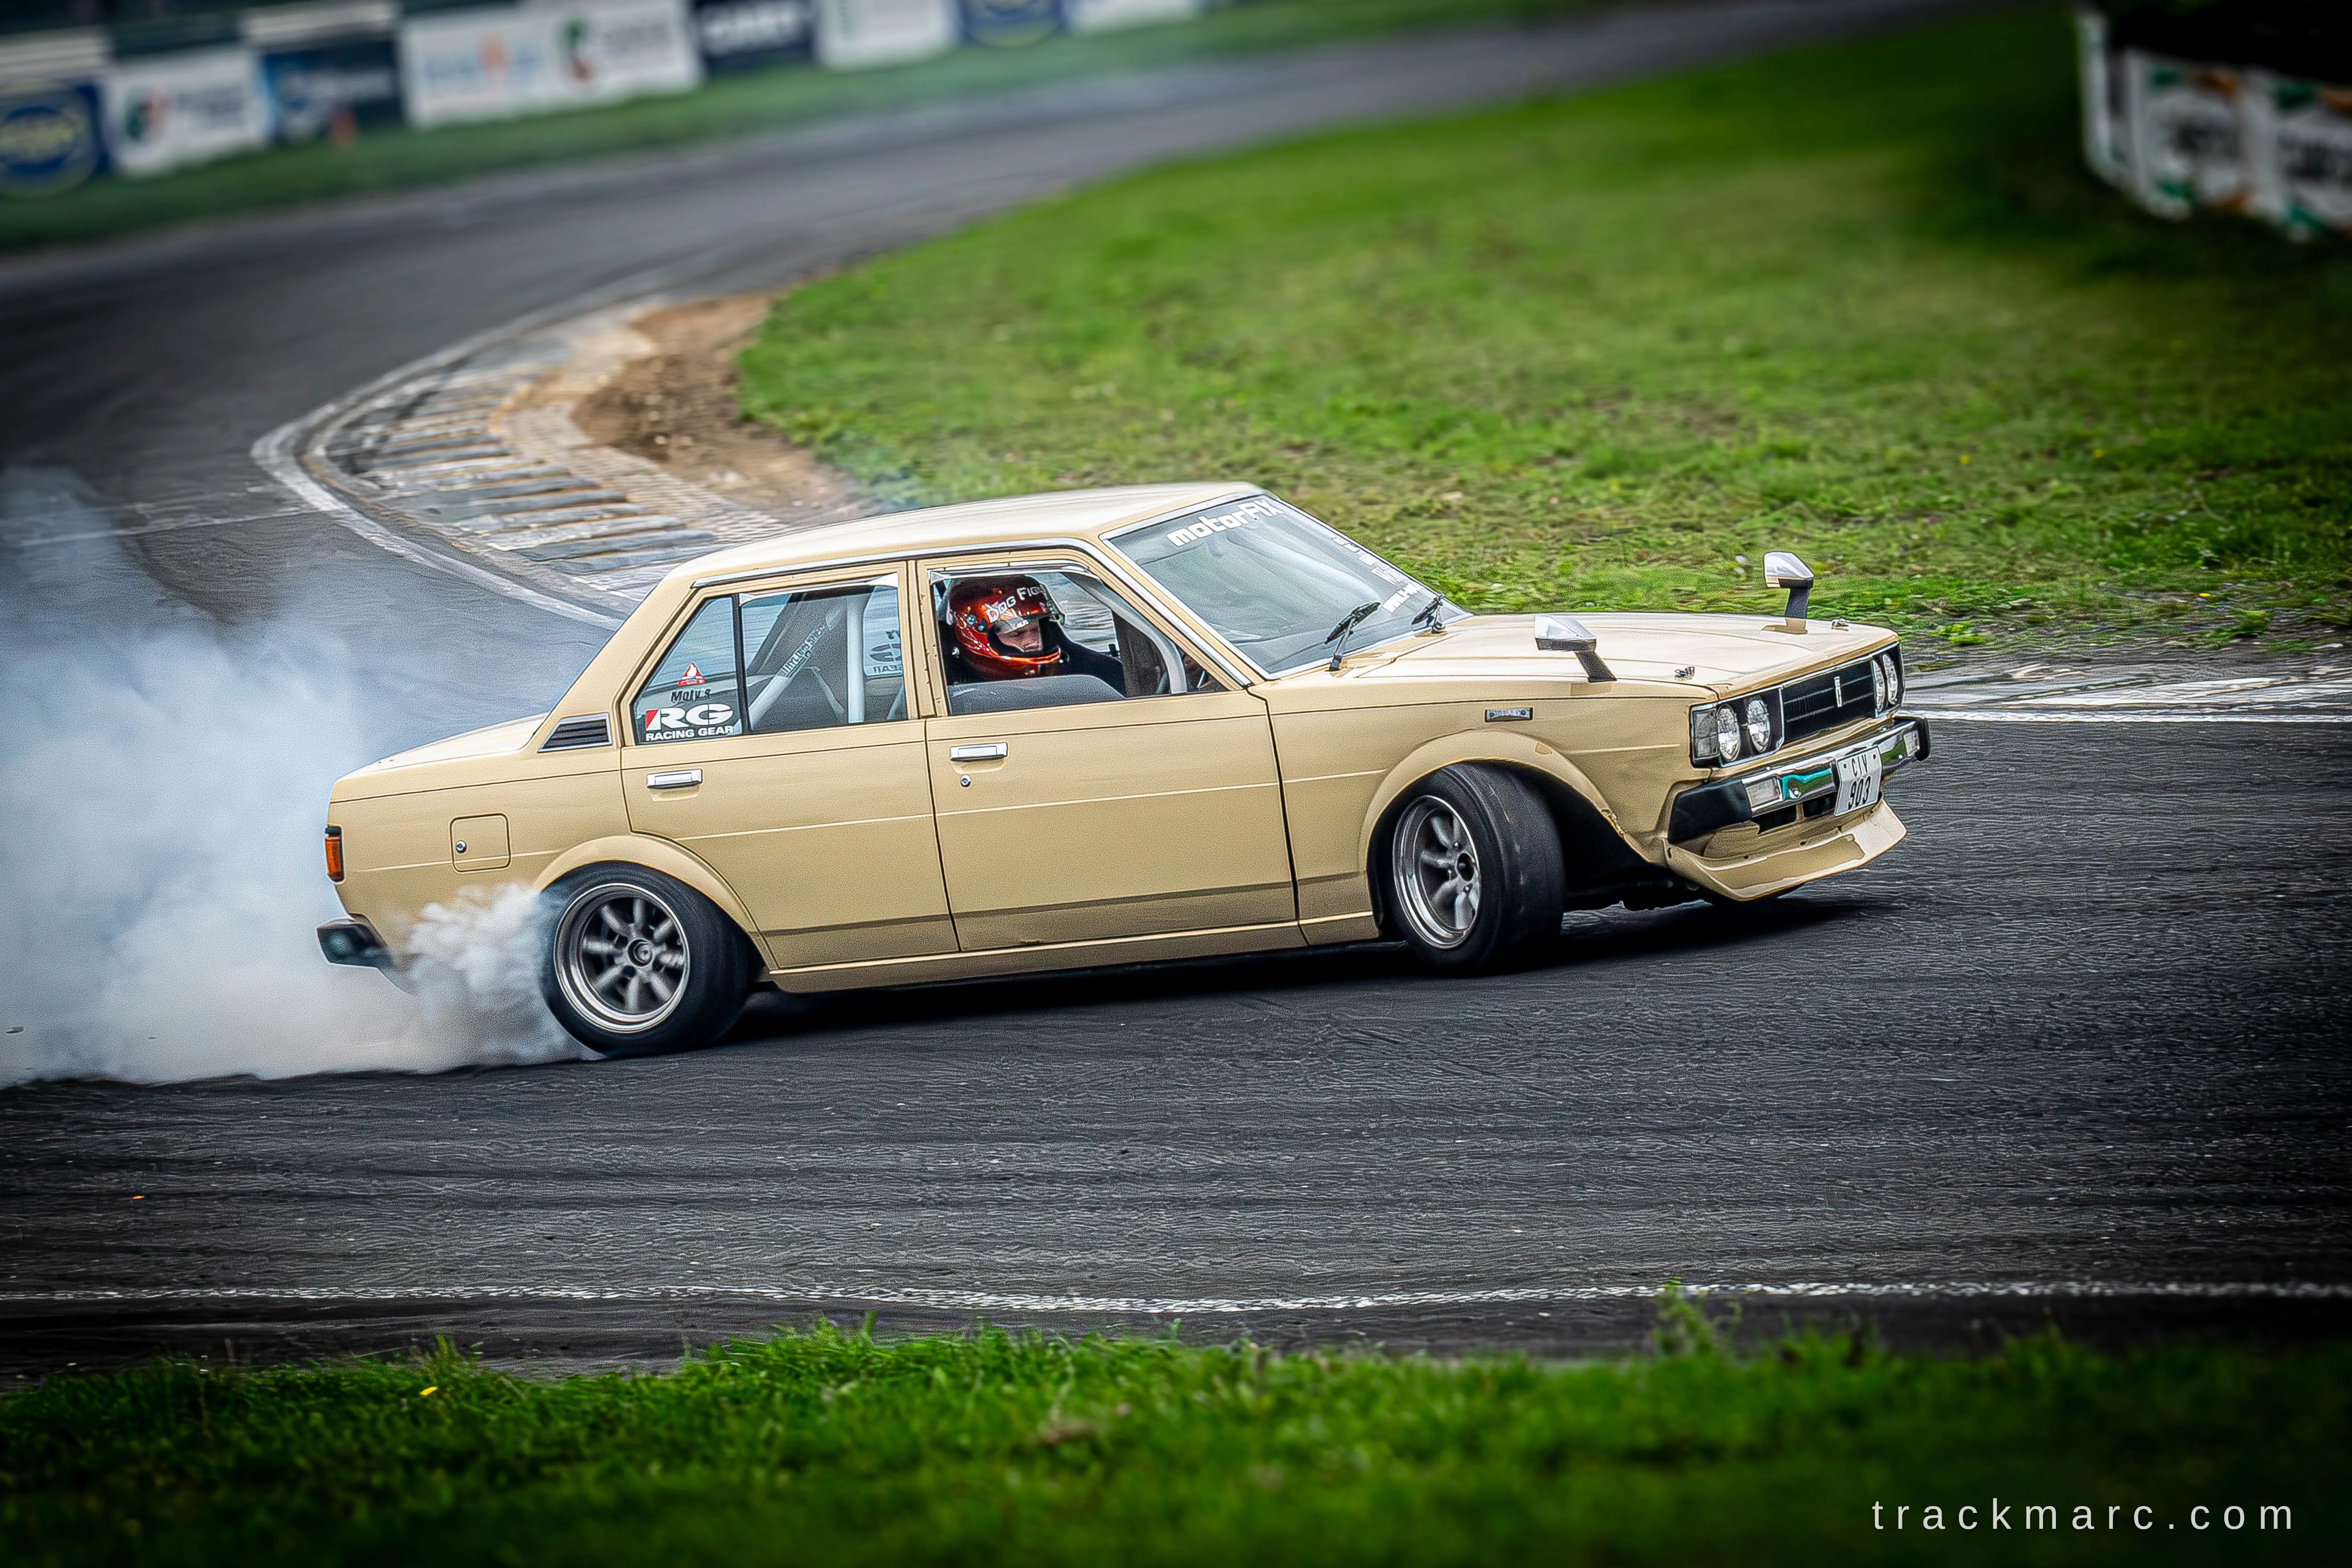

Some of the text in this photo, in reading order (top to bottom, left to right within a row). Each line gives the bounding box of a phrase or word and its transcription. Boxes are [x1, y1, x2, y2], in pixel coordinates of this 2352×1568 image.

[645, 703, 733, 731] RG
[646, 725, 733, 741] RACING GEAR
[1848, 776, 1871, 810] 903
